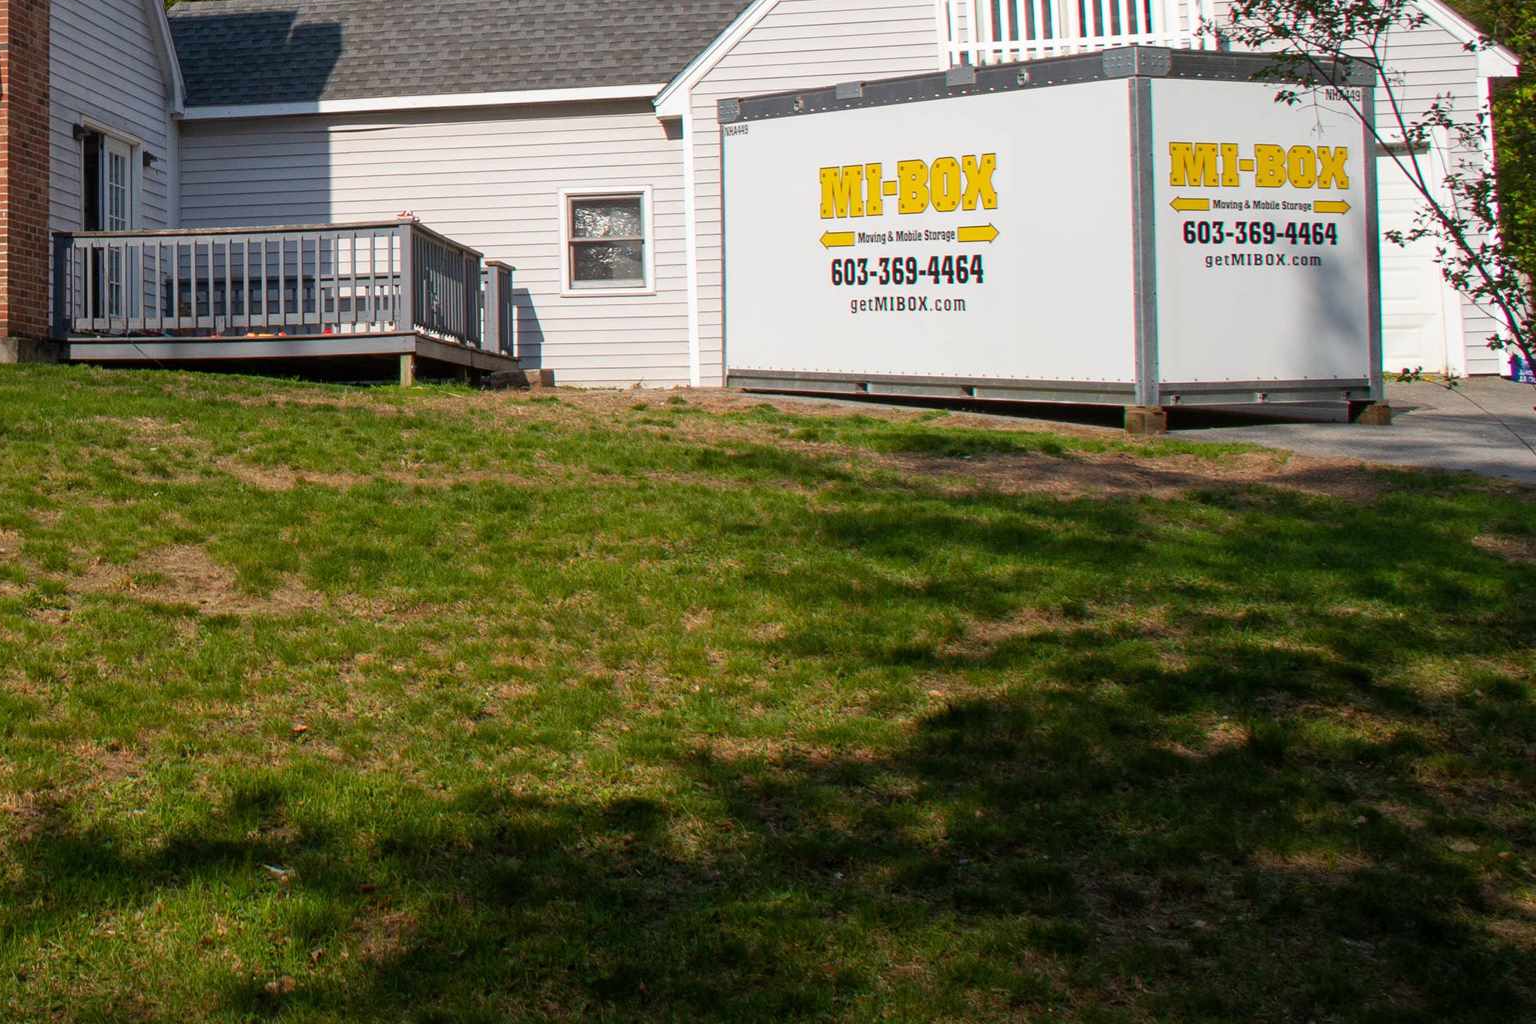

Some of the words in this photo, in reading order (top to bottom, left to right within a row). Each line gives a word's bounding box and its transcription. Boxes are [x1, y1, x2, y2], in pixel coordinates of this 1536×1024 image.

[1169, 142, 1349, 189] MI-BOX
[819, 153, 998, 218] MI-BOX
[1213, 199, 1243, 211] Moving
[1244, 200, 1251, 209] &
[1253, 201, 1280, 210] Mobile
[1281, 201, 1312, 212] Storage
[858, 232, 886, 244] Moving
[887, 231, 894, 241] &
[896, 229, 922, 242] Mobile
[924, 229, 955, 241] Storage
[1183, 221, 1337, 245] 603-369-4464
[831, 254, 983, 286] 603-369-4464
[1205, 253, 1322, 268] getMIBOX.com
[850, 296, 966, 314] getMIBOX.com
